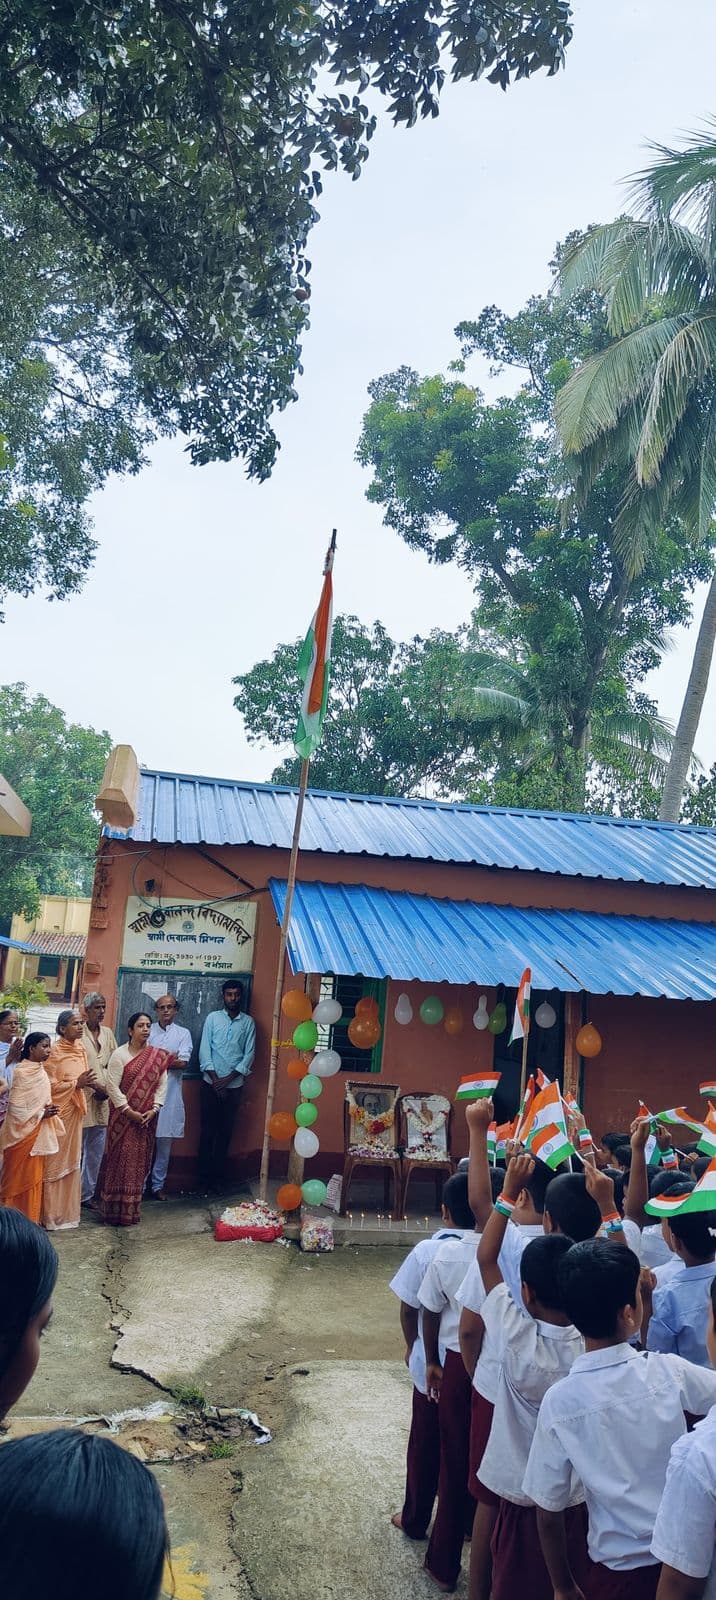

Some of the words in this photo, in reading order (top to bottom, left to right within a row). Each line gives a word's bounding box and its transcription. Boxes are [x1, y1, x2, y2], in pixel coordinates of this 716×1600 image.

[147, 930, 165, 942] স্বামী
[167, 934, 197, 944] দেবানন্দ
[199, 932, 225, 944] মিশন
[197, 907, 251, 946] বিদ্যামন্দির
